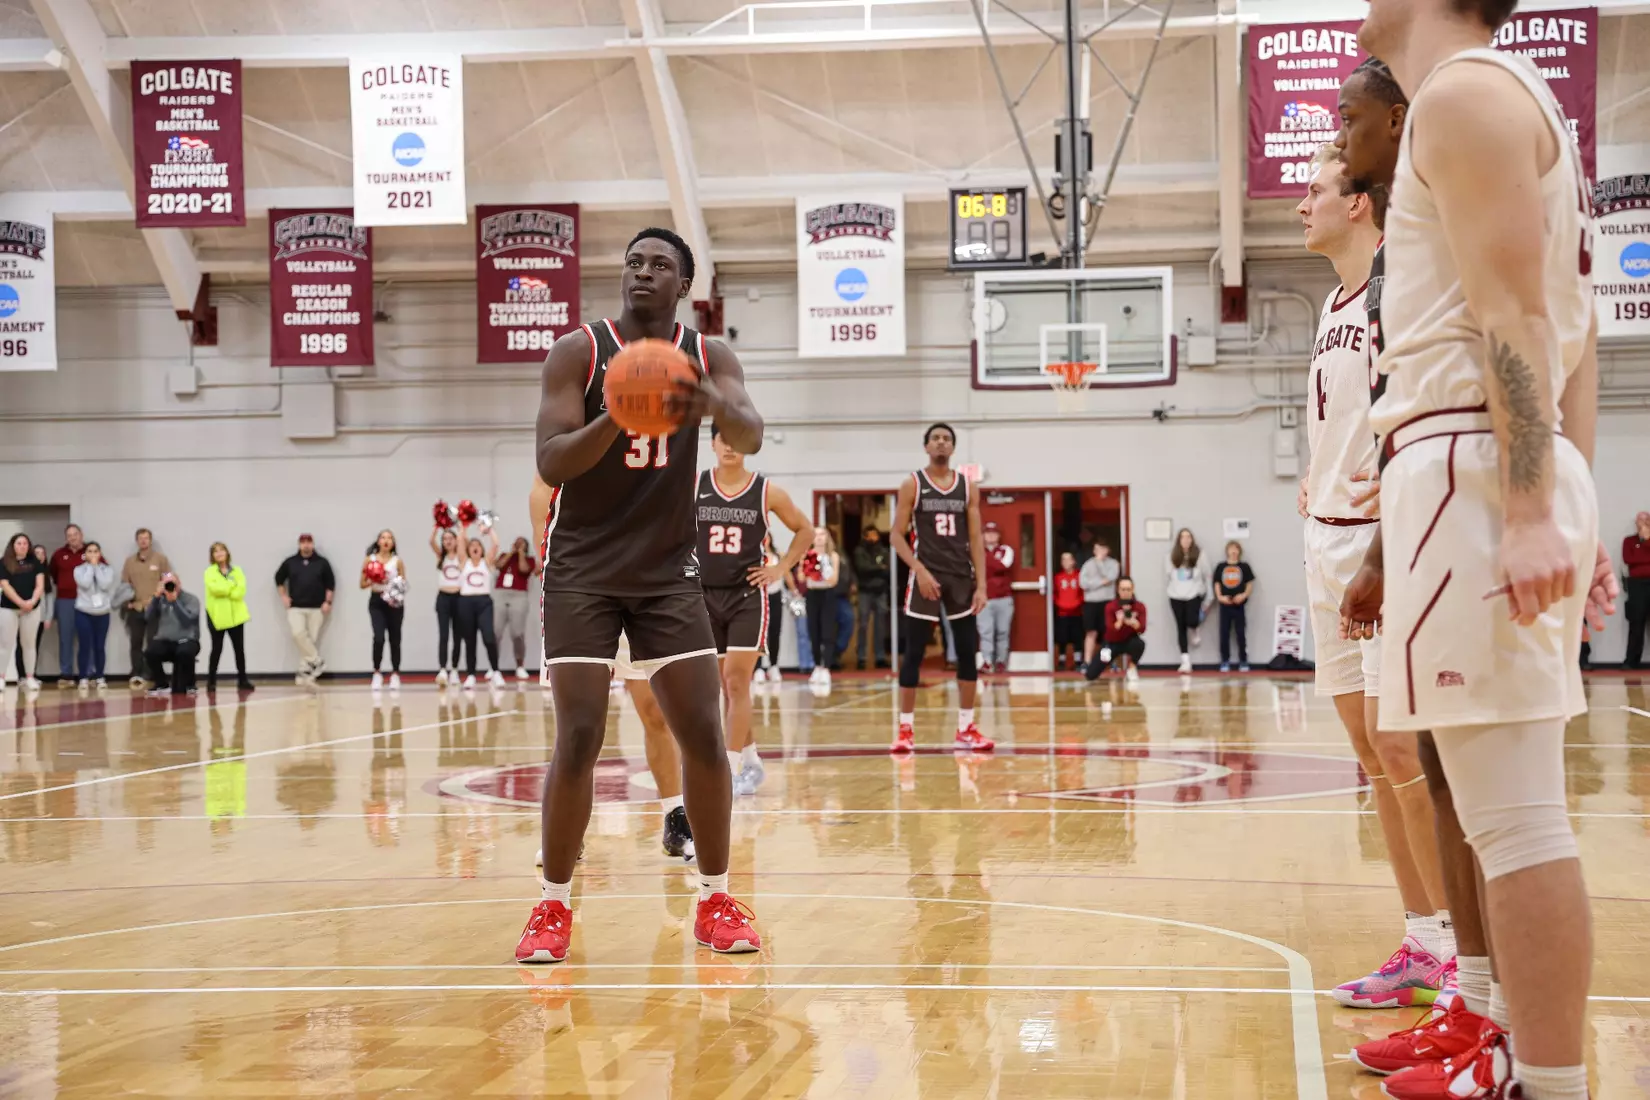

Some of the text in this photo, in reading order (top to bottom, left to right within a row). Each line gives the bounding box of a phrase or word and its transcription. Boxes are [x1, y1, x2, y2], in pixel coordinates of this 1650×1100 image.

[1258, 29, 1358, 60] COLGATE
[1277, 58, 1339, 70] RAIDERS
[140, 67, 233, 96] COLGATE
[361, 64, 451, 91] COLGATE
[1273, 77, 1341, 92] VOLLEYBALL
[159, 95, 216, 106] RAIDERS
[170, 108, 205, 120] MEN'S
[391, 106, 422, 115] MEN'S
[155, 119, 221, 132] BASKETBALL
[376, 117, 438, 127] BASKETBALL
[1264, 143, 1319, 158] CHAMP
[150, 162, 229, 175] TOURNAMENT
[150, 174, 229, 188] CHAMPIONS
[366, 171, 452, 185] TOURNAMENT
[147, 192, 233, 215] 2020-21
[387, 190, 433, 209] 2021
[483, 211, 574, 238] COLGATE
[805, 203, 896, 232] COLGATE
[816, 249, 886, 261] VOLLEYBALL
[0, 260, 18, 268] N'S
[286, 260, 357, 273] VOLLEYBALL
[492, 257, 564, 270] VOLLEYBALL
[0, 270, 35, 279] TBALL
[291, 284, 353, 298] REGULAR
[296, 298, 348, 311] SEASON
[489, 302, 569, 315] TOURNAMENT
[283, 311, 361, 326] CHAMPIONS
[808, 305, 894, 319] TOURNAMENT
[489, 313, 569, 326] CHAMPIONS
[507, 329, 555, 350] 1996
[830, 323, 877, 342] 1996
[0, 339, 28, 357] 96
[300, 333, 348, 354] 1996
[624, 428, 669, 469] 31
[698, 505, 758, 525] BROWN
[934, 513, 957, 537] 21
[708, 525, 743, 555] 23
[466, 571, 485, 587] C
